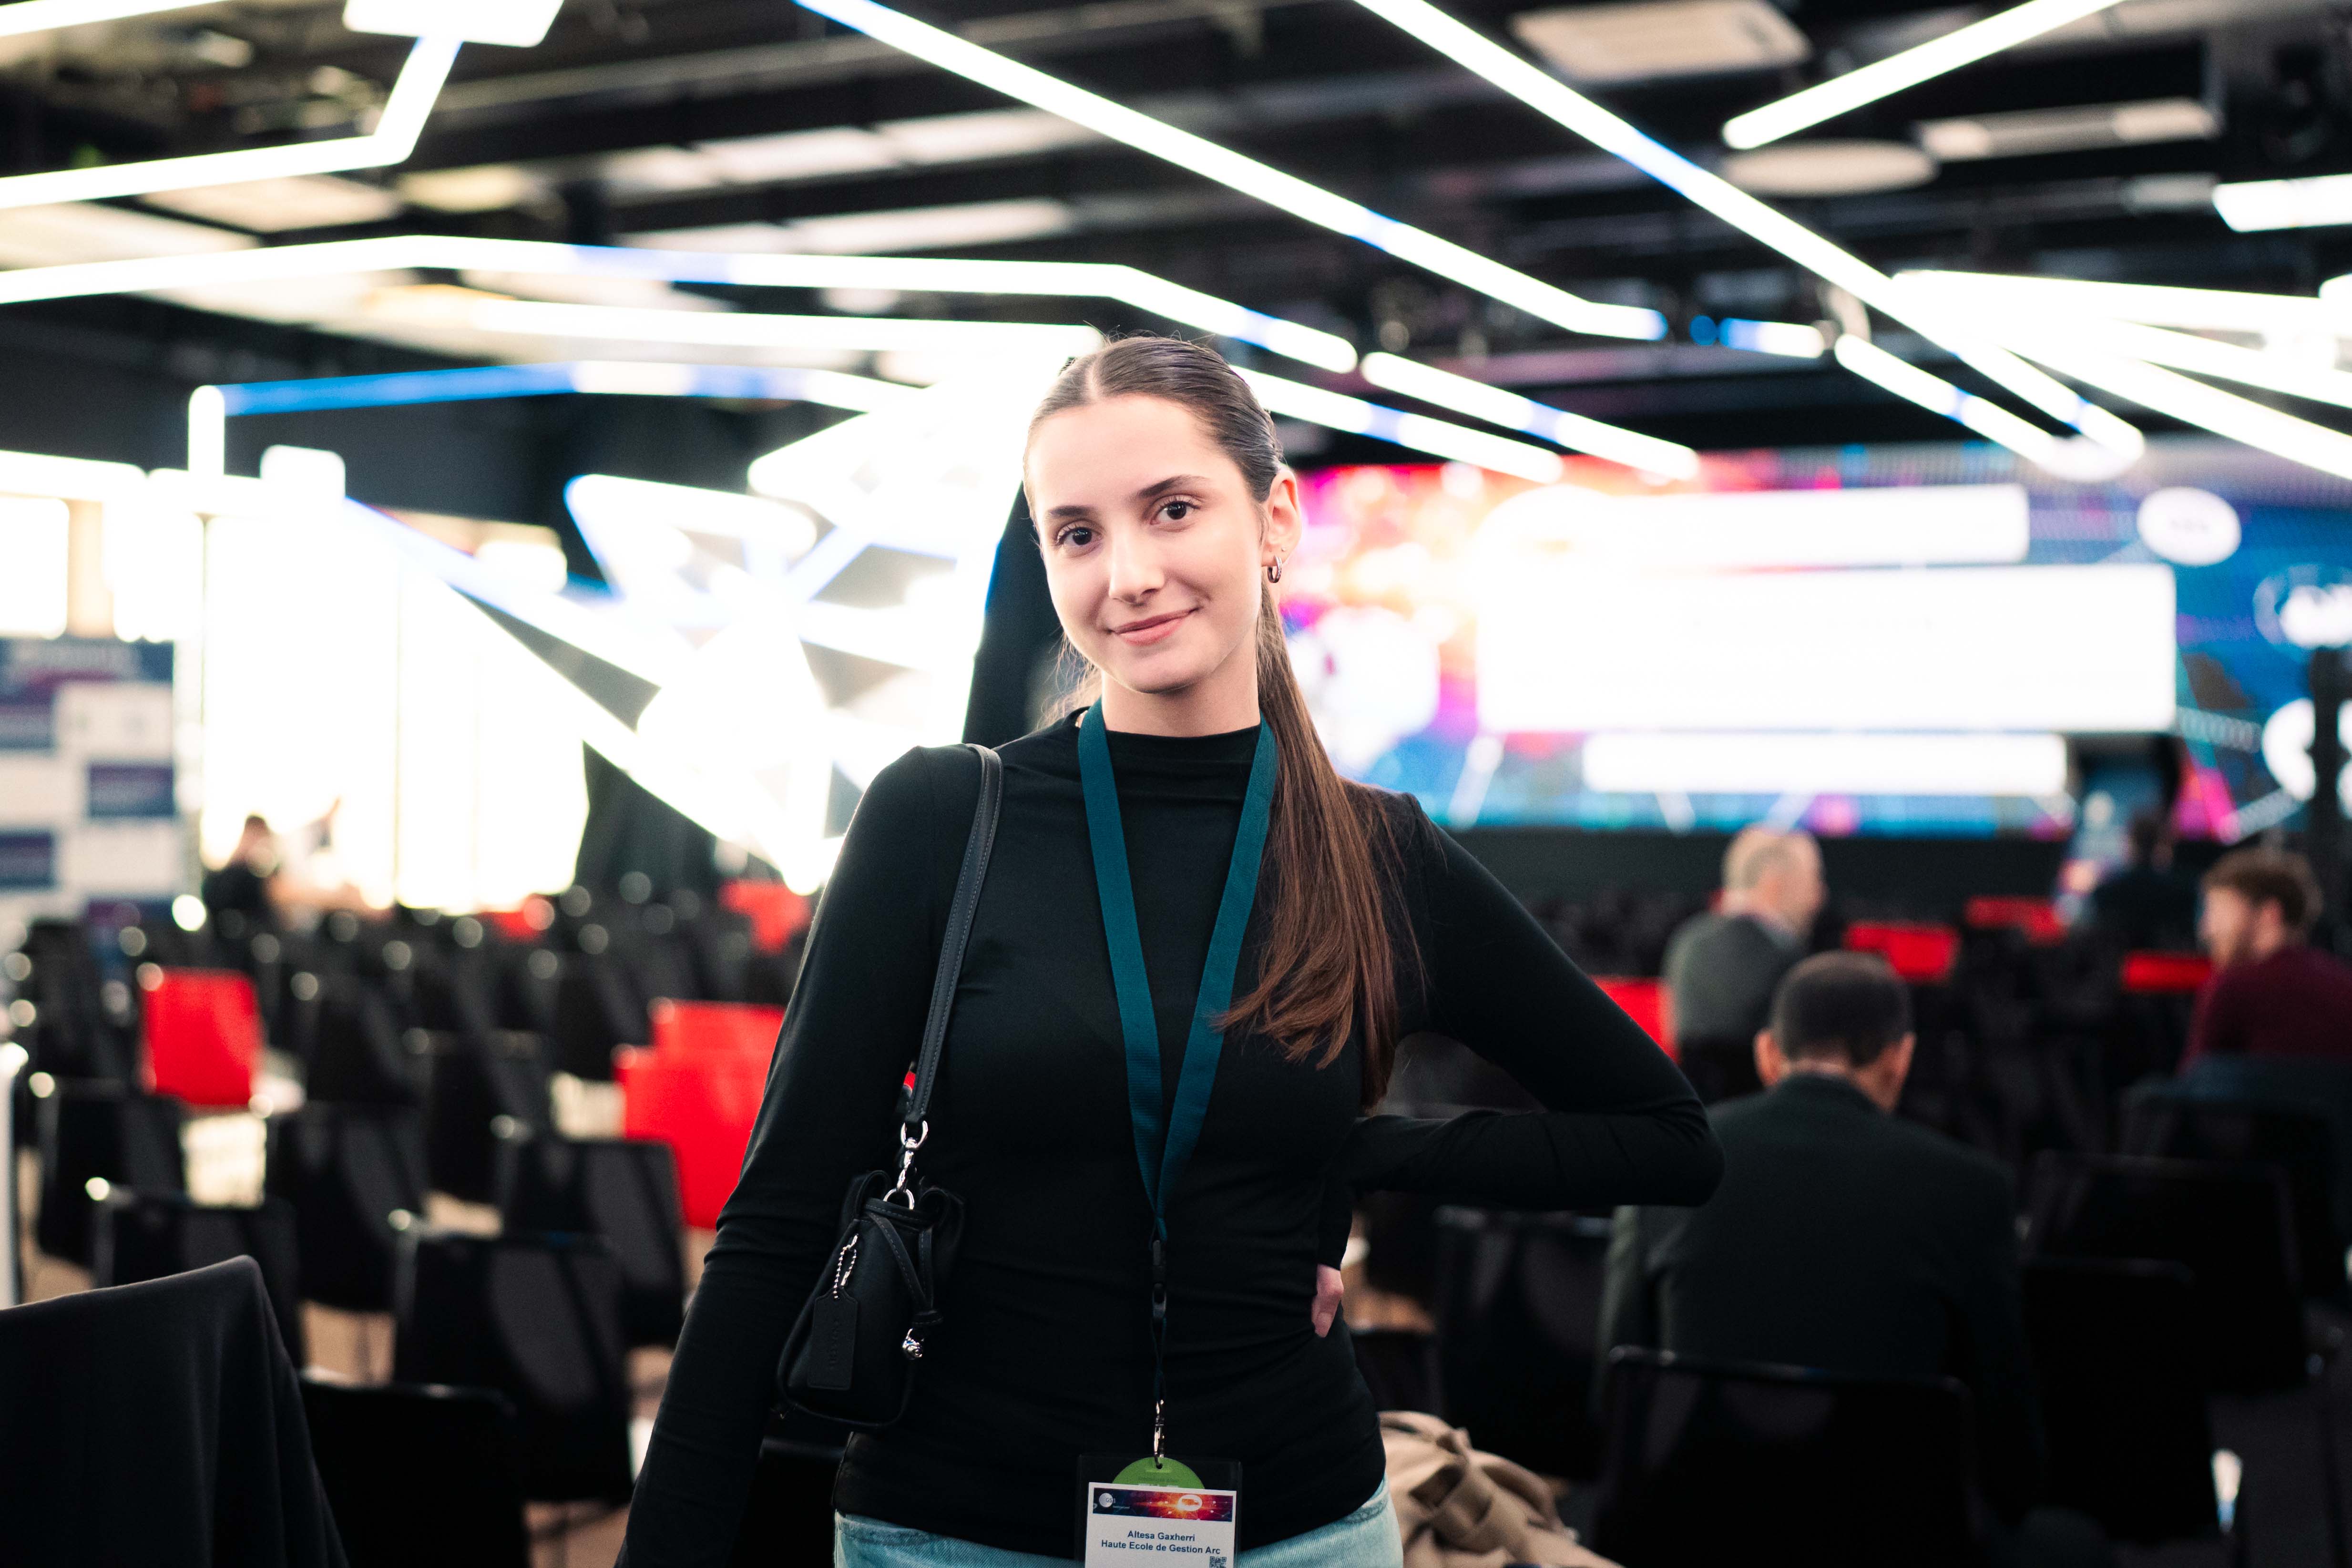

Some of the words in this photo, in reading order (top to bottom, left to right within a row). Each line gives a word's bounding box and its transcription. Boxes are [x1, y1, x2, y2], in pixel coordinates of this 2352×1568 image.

[1127, 1530, 1155, 1539] Altesa
[1157, 1532, 1196, 1541] Gaxherri
[1101, 1539, 1127, 1549] Haute
[1129, 1541, 1154, 1550] Ecole
[1169, 1544, 1203, 1553] Gestion
[1205, 1546, 1221, 1554] Arc
